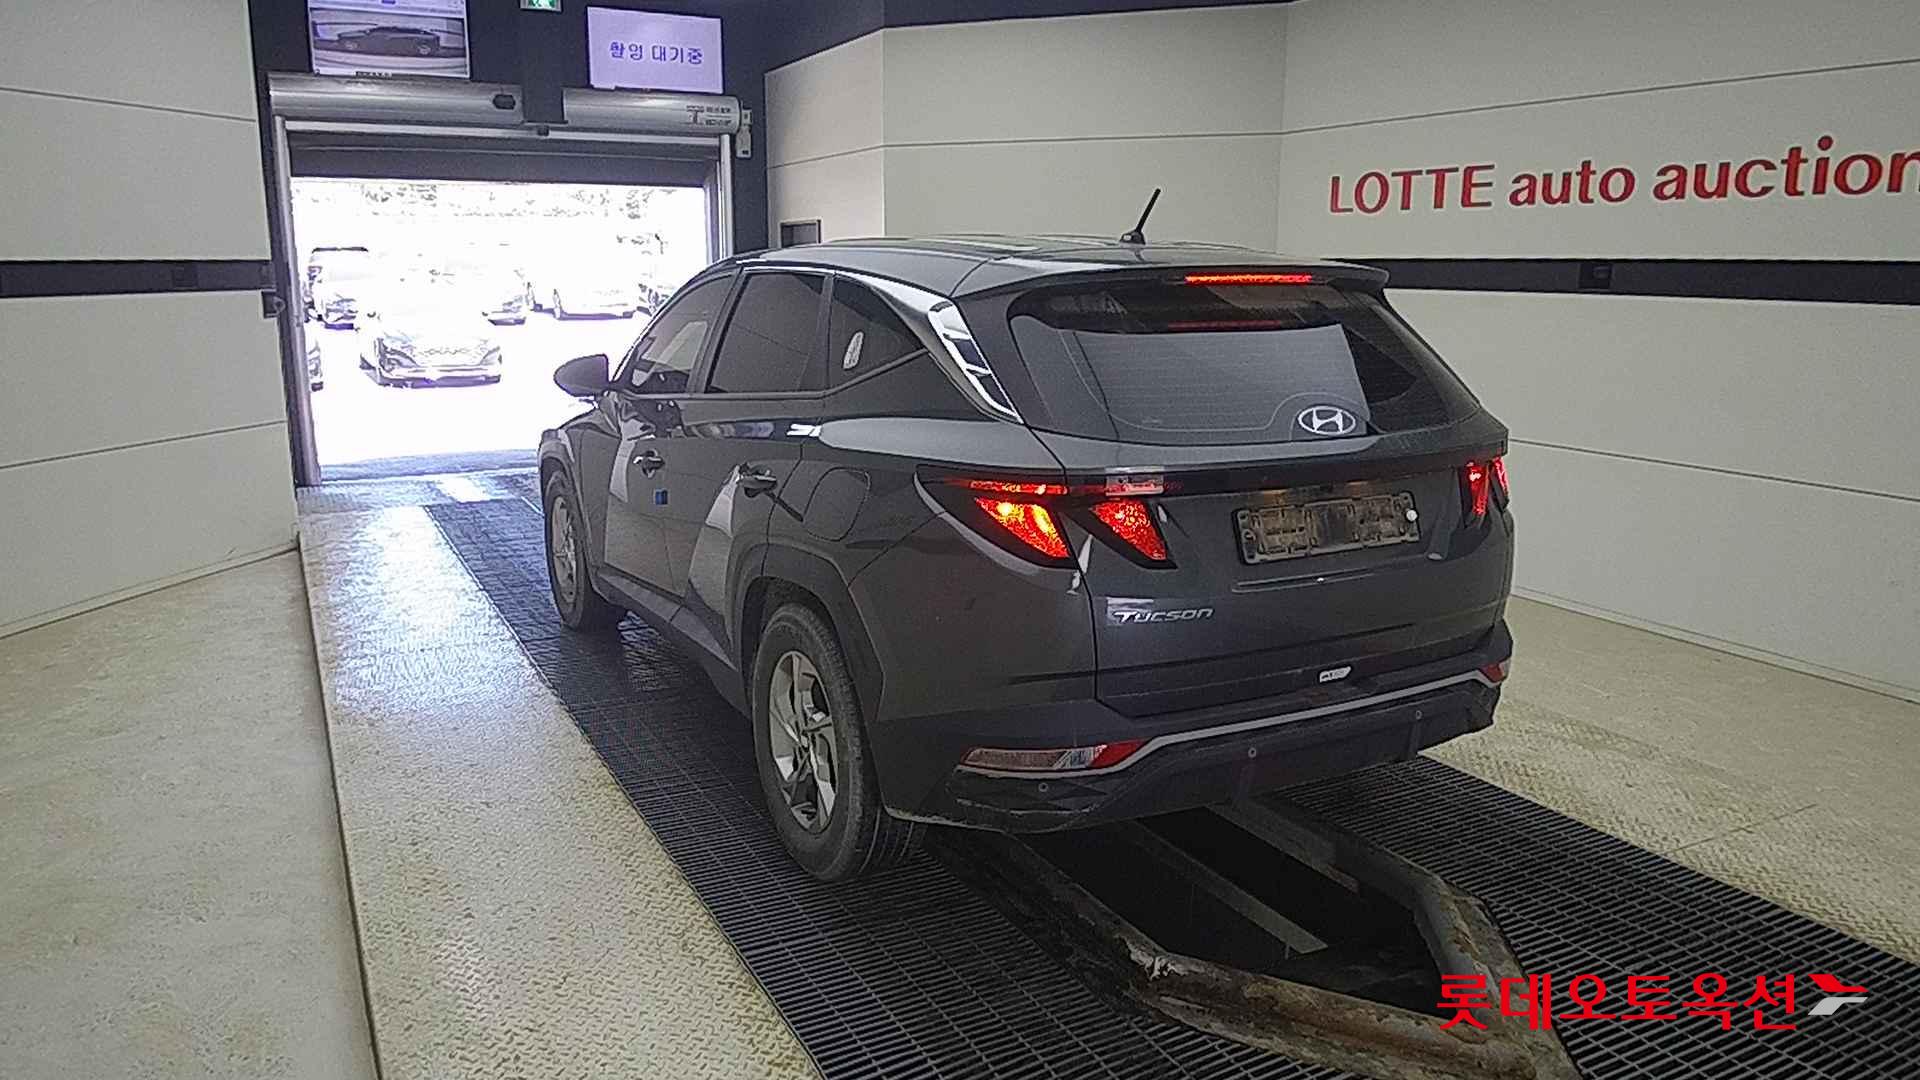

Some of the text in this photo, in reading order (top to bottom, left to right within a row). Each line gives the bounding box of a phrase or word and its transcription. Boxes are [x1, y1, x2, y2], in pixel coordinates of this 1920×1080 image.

[652, 45, 703, 65] 대기중
[1330, 164, 1495, 213] LOTTE
[1509, 160, 1636, 206] auto
